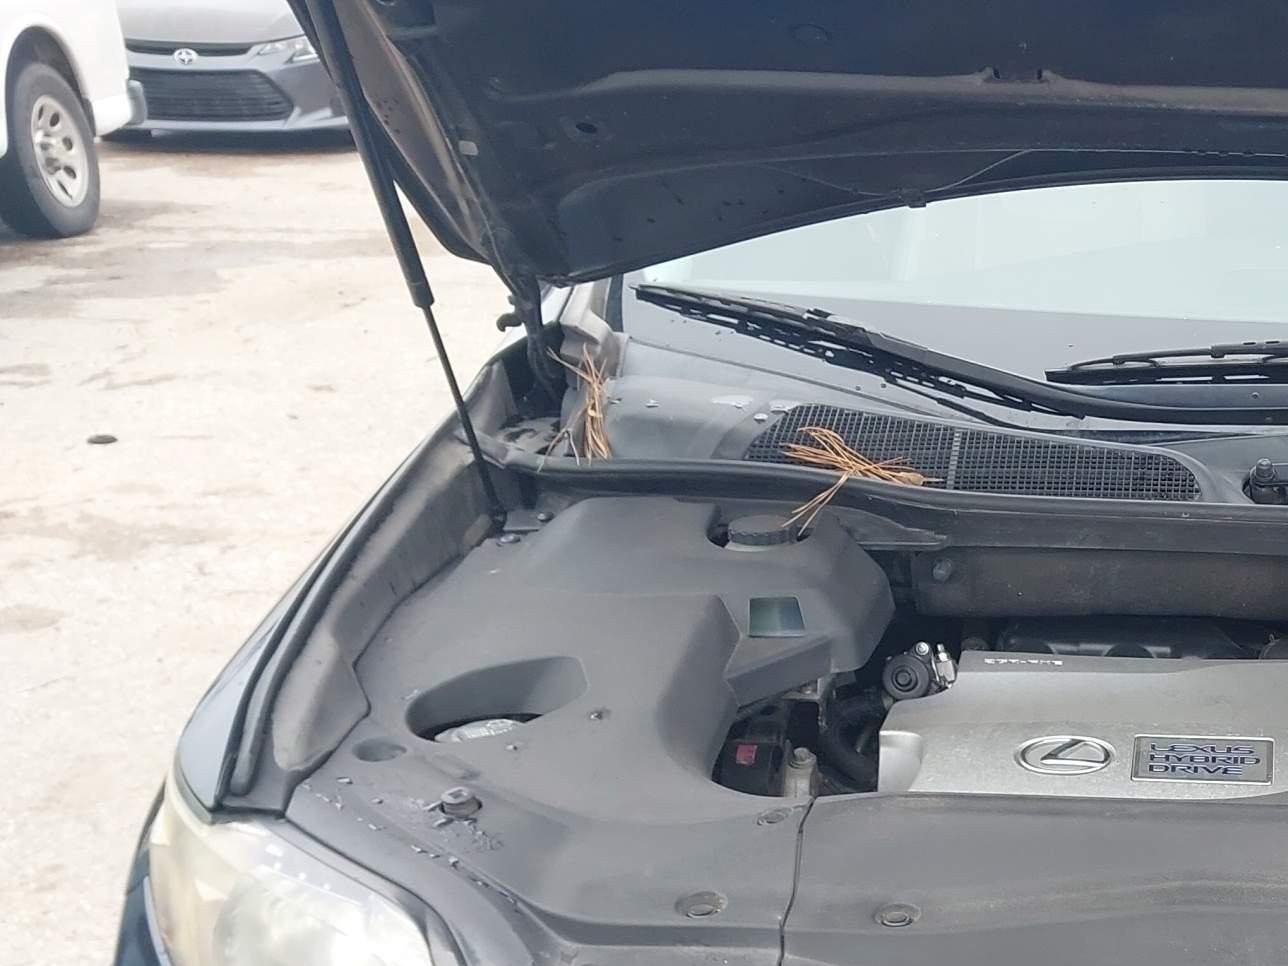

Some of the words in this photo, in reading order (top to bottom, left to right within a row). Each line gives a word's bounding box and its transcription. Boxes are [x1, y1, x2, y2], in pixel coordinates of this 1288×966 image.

[1150, 743, 1254, 754] LEXUS
[1149, 753, 1261, 765] HYBRID
[1148, 763, 1243, 776] DRIVE
